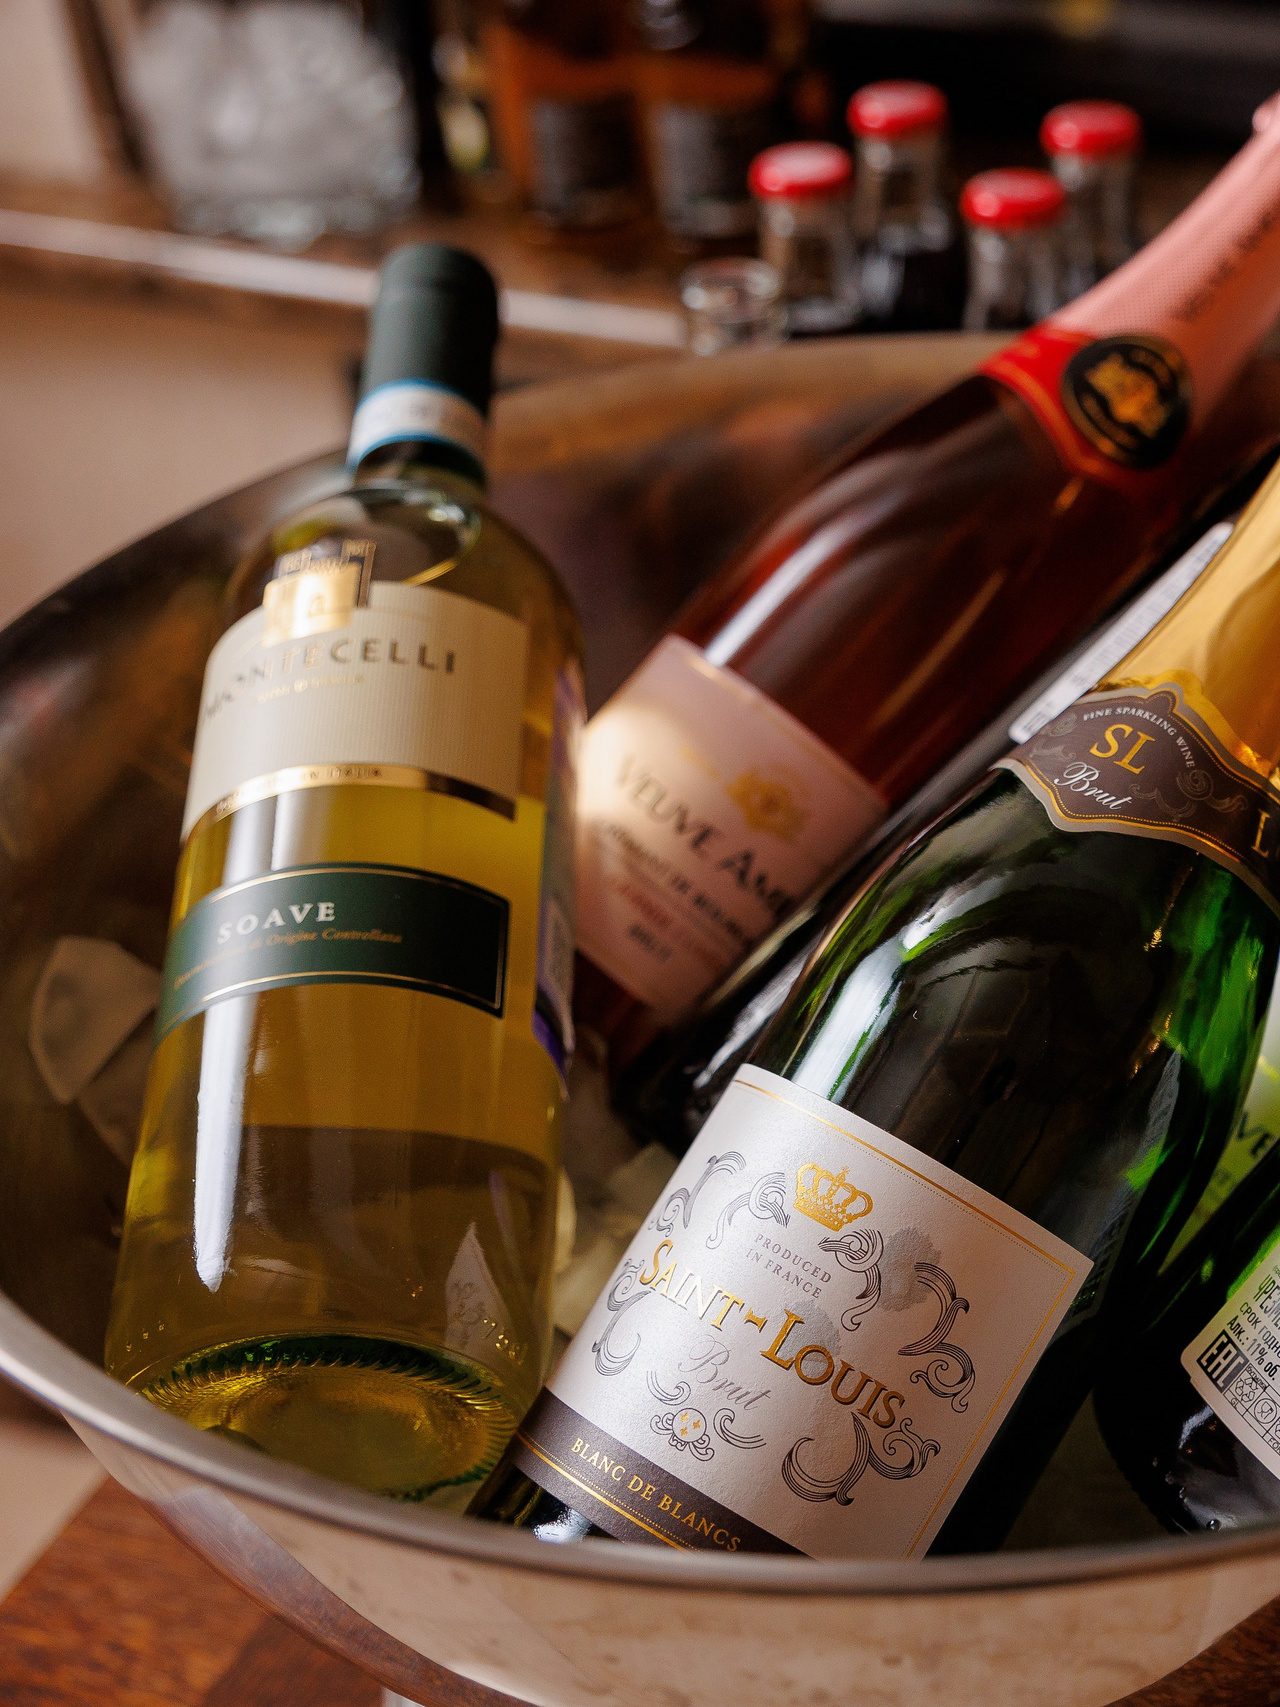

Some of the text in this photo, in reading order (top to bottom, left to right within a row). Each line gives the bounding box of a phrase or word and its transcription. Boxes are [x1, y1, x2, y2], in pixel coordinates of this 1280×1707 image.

[1083, 706, 1195, 769] FINE SPARKLING WINE
[1089, 723, 1156, 775] SL
[1053, 760, 1132, 810] Brut
[216, 901, 337, 945] SOAVE
[745, 1247, 824, 1299] IN FRANCE
[752, 1233, 833, 1284] PRODUCED
[1225, 1314, 1252, 1346] Алк.:
[1245, 1337, 1269, 1366] 11%
[1238, 1300, 1262, 1330] СРОК
[677, 1334, 772, 1412] Brut
[1229, 1396, 1240, 1409] GL
[571, 1437, 742, 1553] BLANC DE BLANCS
